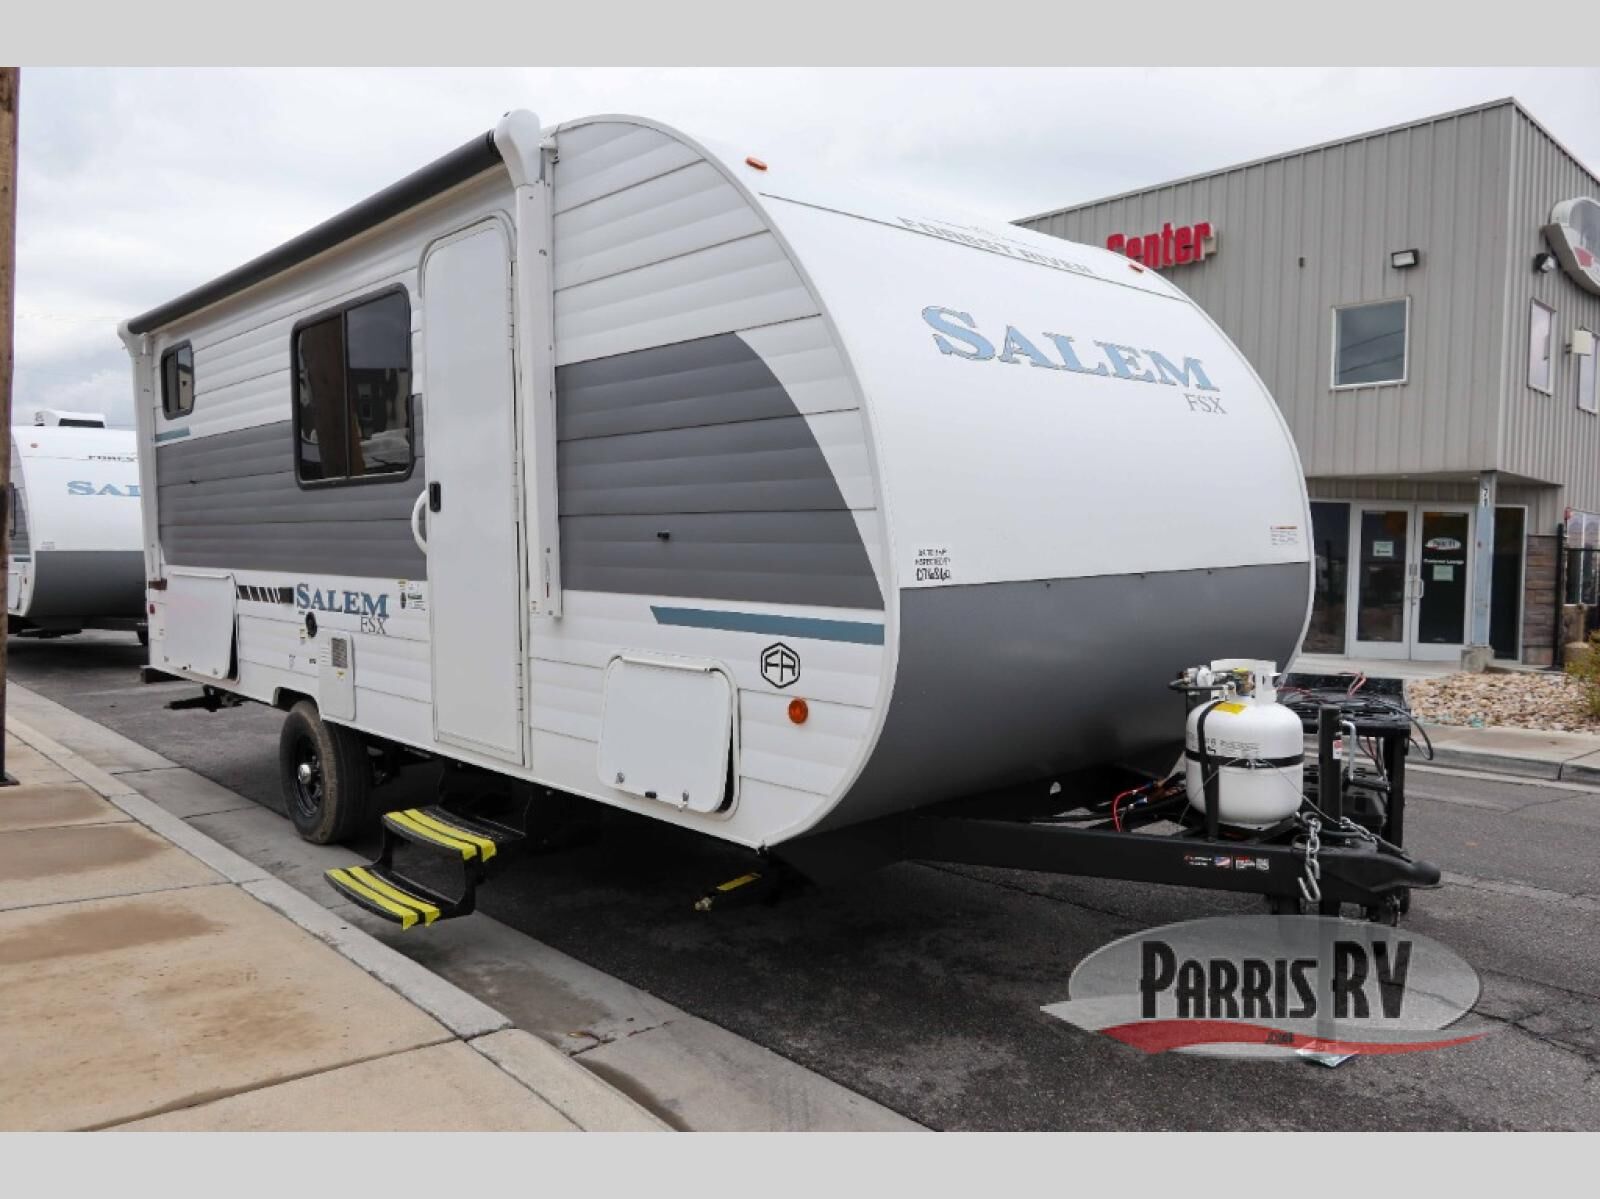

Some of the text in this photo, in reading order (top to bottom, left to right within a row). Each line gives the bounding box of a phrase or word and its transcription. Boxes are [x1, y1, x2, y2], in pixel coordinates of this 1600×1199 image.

[921, 305, 1220, 392] SALEM
[1183, 393, 1228, 415] FSX
[297, 582, 389, 618] SALEM
[360, 616, 387, 635] FSX
